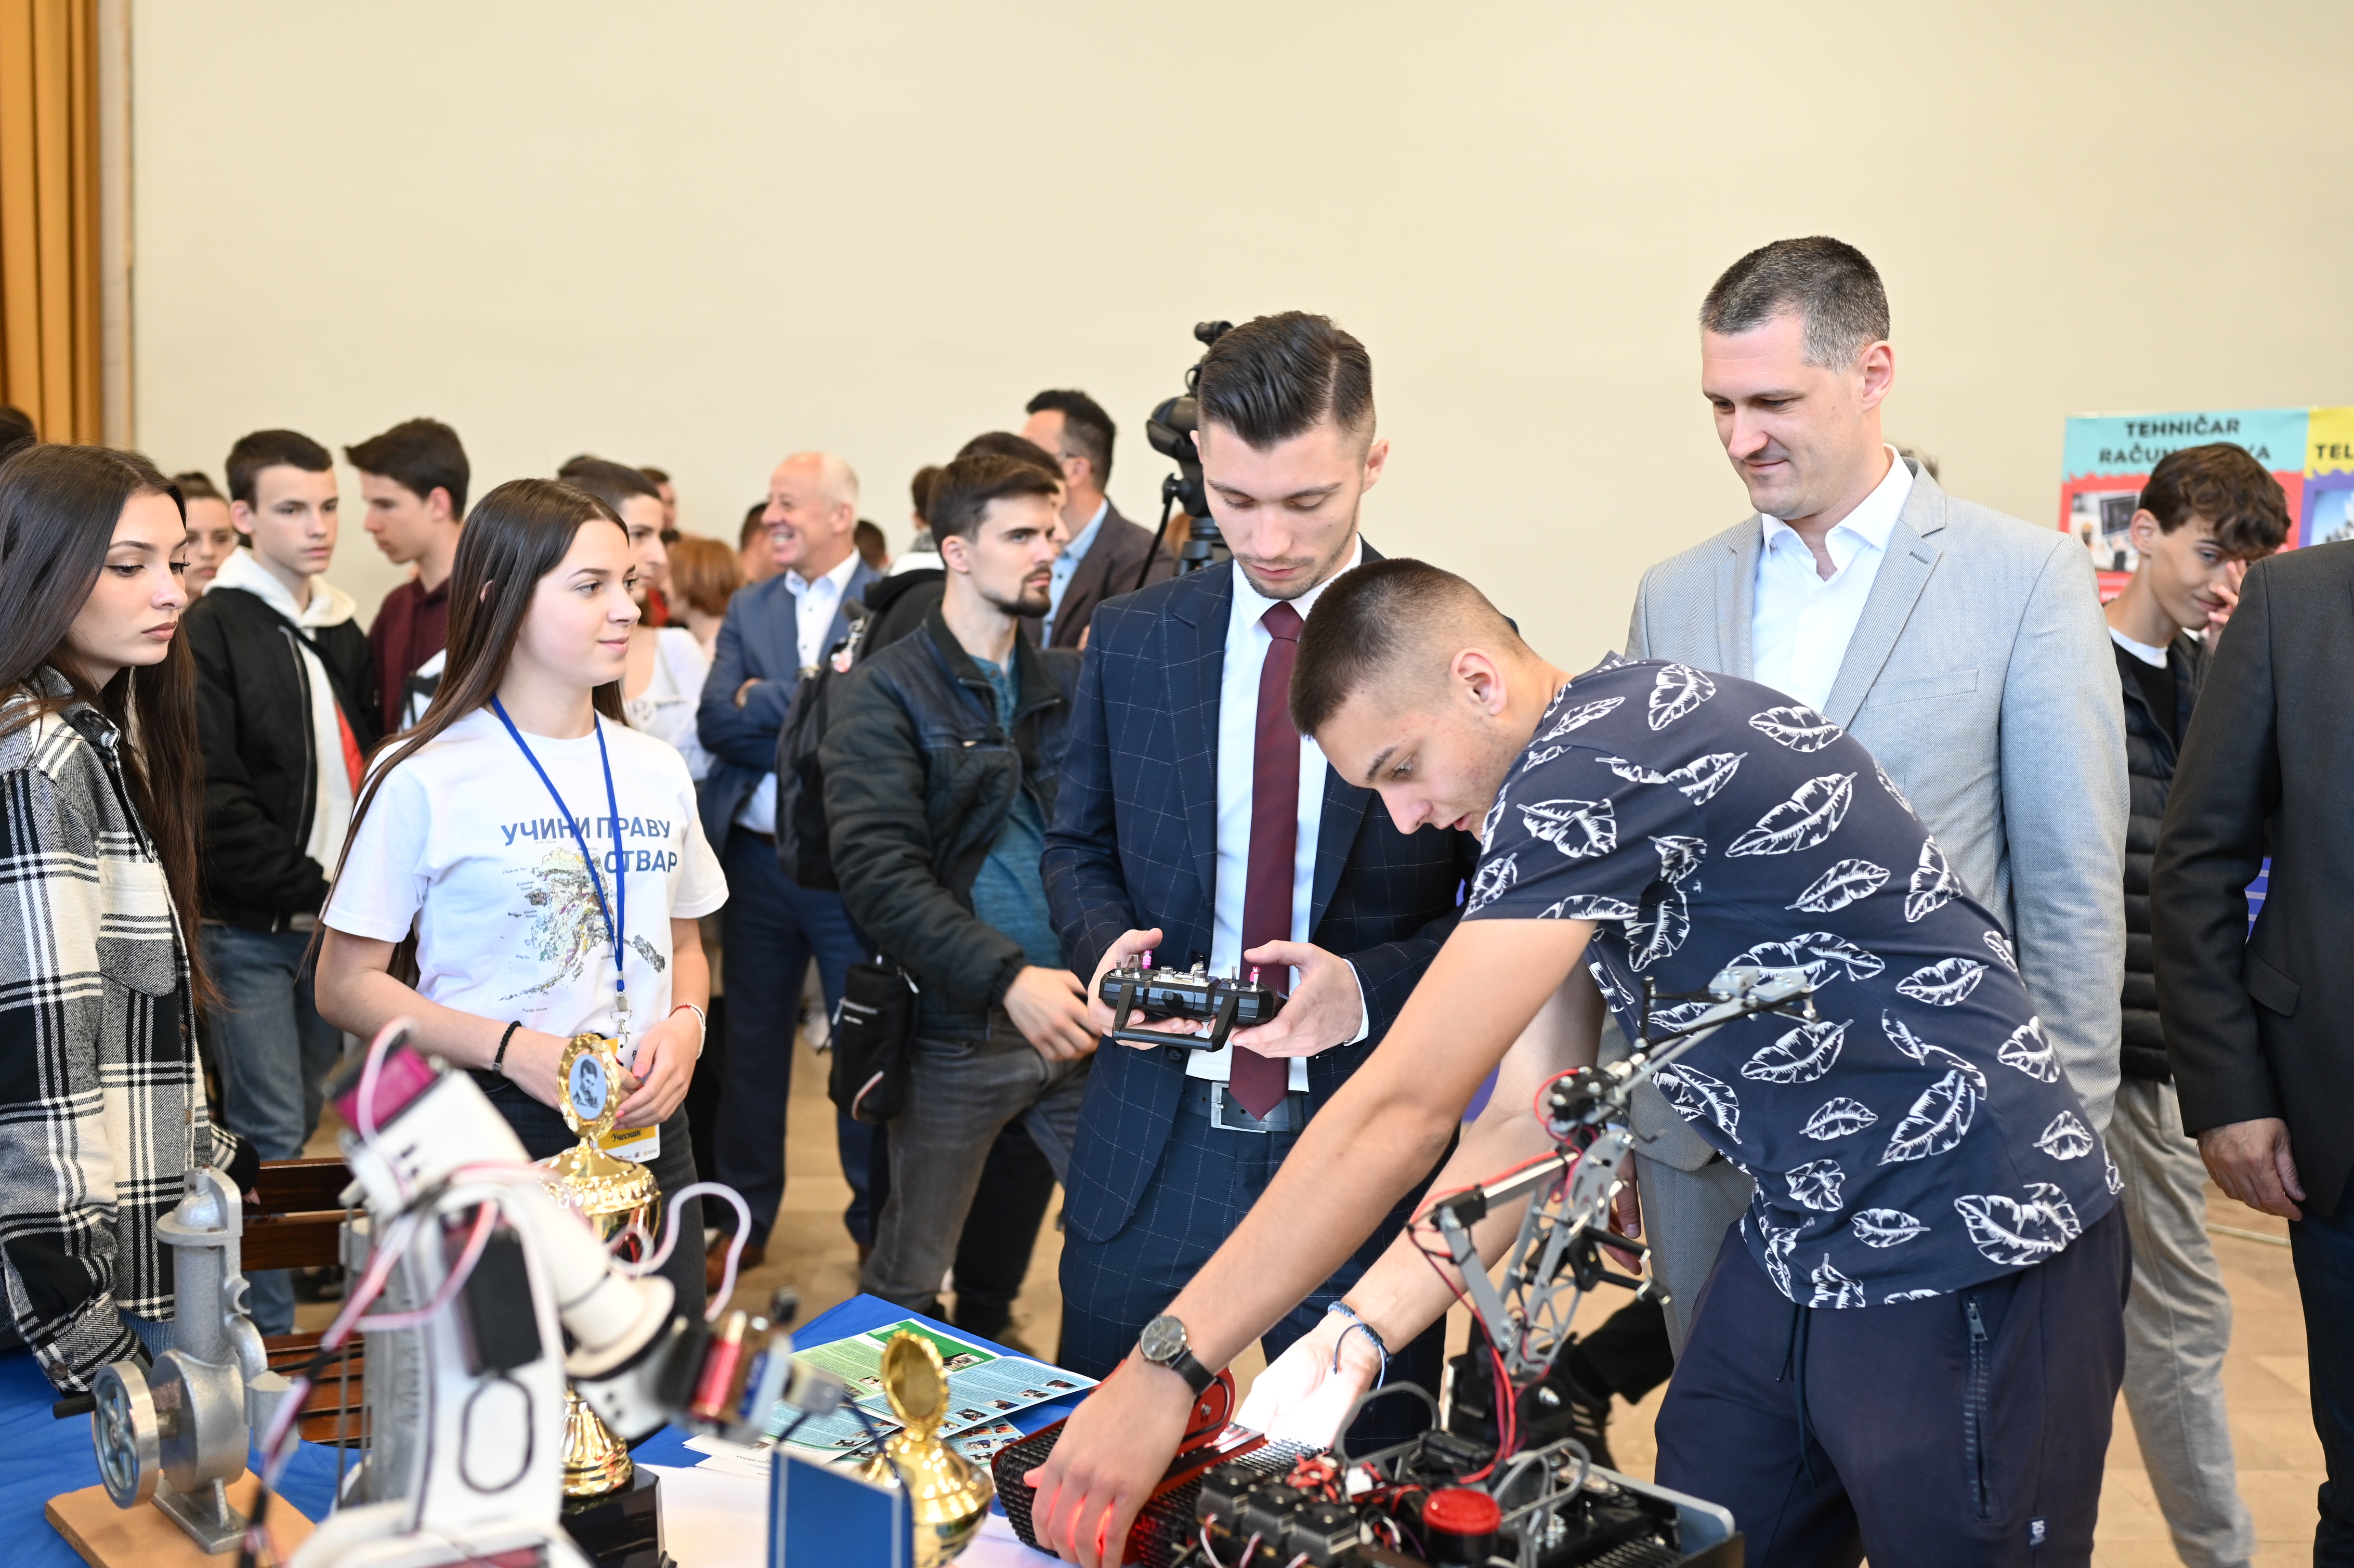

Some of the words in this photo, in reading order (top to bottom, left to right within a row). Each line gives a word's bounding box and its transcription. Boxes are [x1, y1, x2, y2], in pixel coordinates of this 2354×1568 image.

[2126, 414, 2240, 437] TEHNIČAR
[501, 817, 590, 846] УЧИНИ
[597, 817, 670, 838] ПРАВУ
[604, 850, 677, 873] СТВАР
